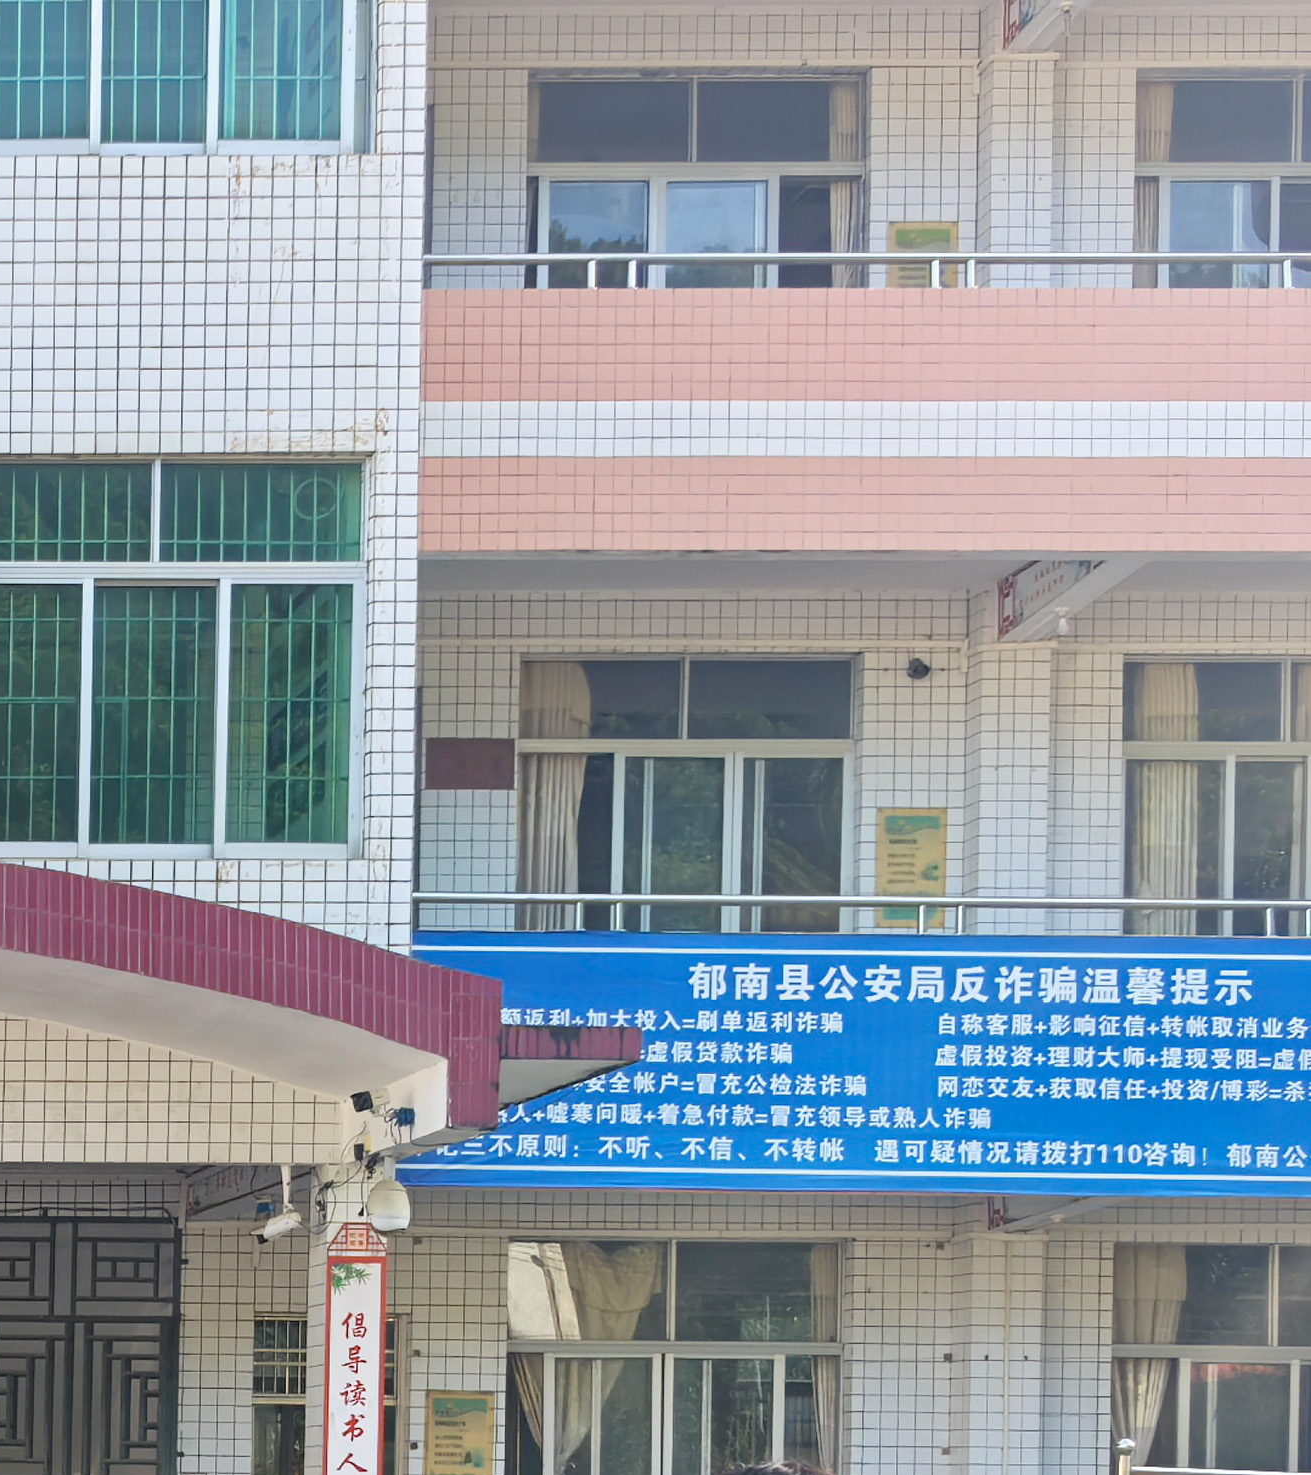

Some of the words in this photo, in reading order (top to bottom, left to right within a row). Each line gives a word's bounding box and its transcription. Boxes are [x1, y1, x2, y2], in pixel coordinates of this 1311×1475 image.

[688, 960, 1254, 1007] 郁南县公安局反诈骗温馨提示
[937, 1012, 1310, 1040] 自称客服+影响征信+转帐取消业务
[937, 1075, 1311, 1103] 网恋交友+获取信任+投资/博彩=杀
